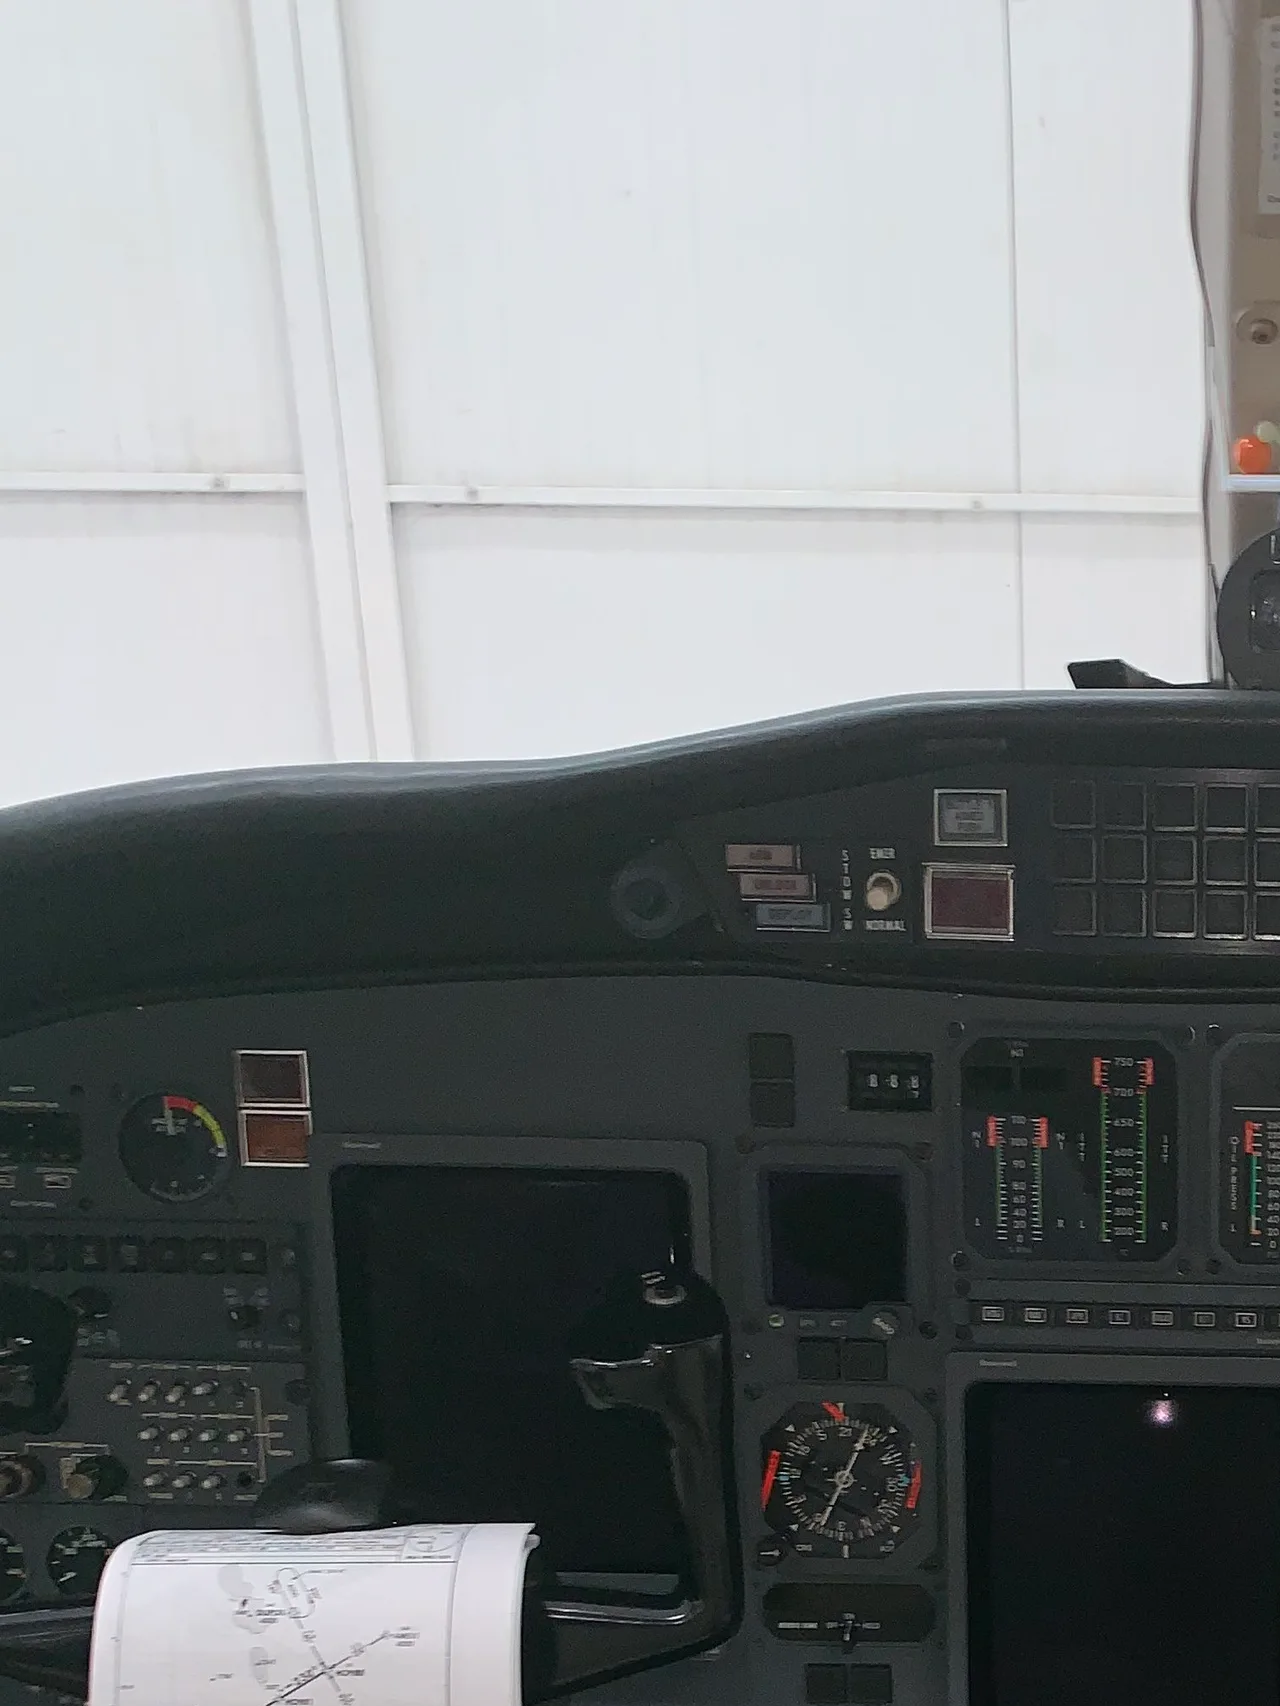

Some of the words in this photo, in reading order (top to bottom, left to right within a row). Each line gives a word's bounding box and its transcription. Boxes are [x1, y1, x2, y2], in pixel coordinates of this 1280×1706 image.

[1113, 1057, 1134, 1067] 750
[1113, 1118, 1134, 1127] 650
[1113, 1148, 1134, 1157] 600
[1113, 1167, 1134, 1177] 500
[1113, 1187, 1134, 1196] 400
[1229, 1167, 1238, 1211] PRESS
